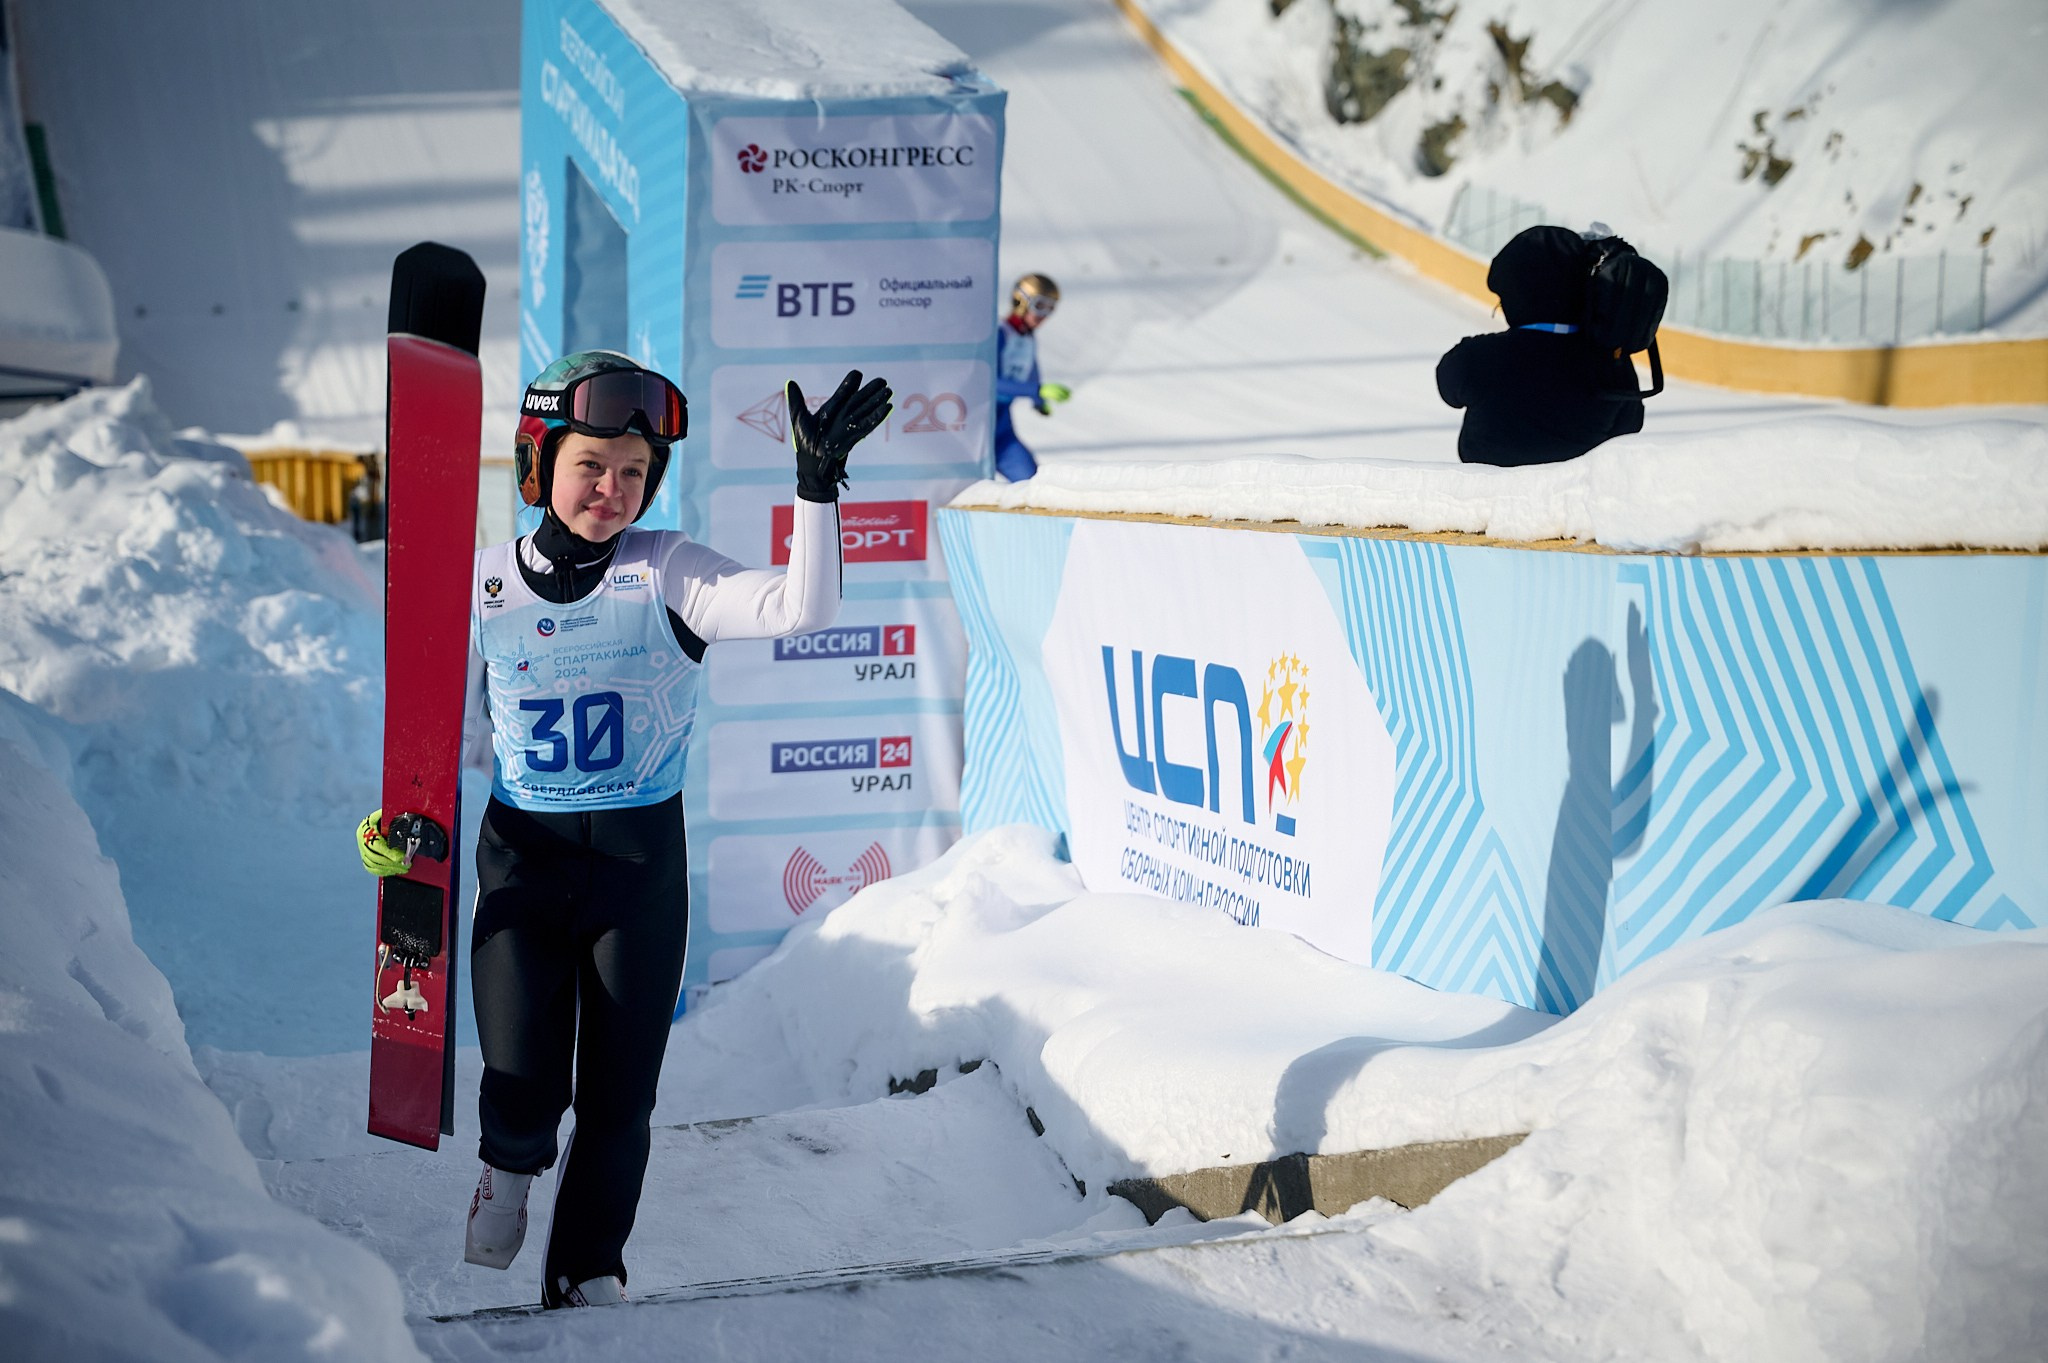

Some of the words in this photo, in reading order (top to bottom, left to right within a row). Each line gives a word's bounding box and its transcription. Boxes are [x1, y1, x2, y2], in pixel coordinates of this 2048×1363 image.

[773, 144, 974, 169] РОСКОНГРЕСС
[878, 275, 974, 293] Официальный
[776, 282, 855, 318] ВТБ
[878, 295, 932, 309] спонсор
[525, 393, 560, 411] uvex
[553, 638, 623, 655] ВСЕРОССИЙСКАЯ
[782, 632, 872, 654] РОССИЯ
[891, 629, 905, 652] 1
[554, 645, 647, 666] СПАРТАКИАДА
[555, 667, 587, 679] 2024
[855, 661, 916, 681] УРАЛ
[519, 691, 624, 773] 30
[1101, 645, 1256, 825] ЦСП
[779, 744, 869, 768] РОССИЯ
[882, 742, 910, 763] 24
[522, 780, 635, 797] СВЕРДЛОВСКАЯ
[851, 773, 912, 792] УРАЛ
[1124, 799, 1151, 838] ЦЕНТР
[1229, 836, 1311, 899] ПОДГОТОВКИ
[1121, 846, 1172, 896] СБОРНЫХ
